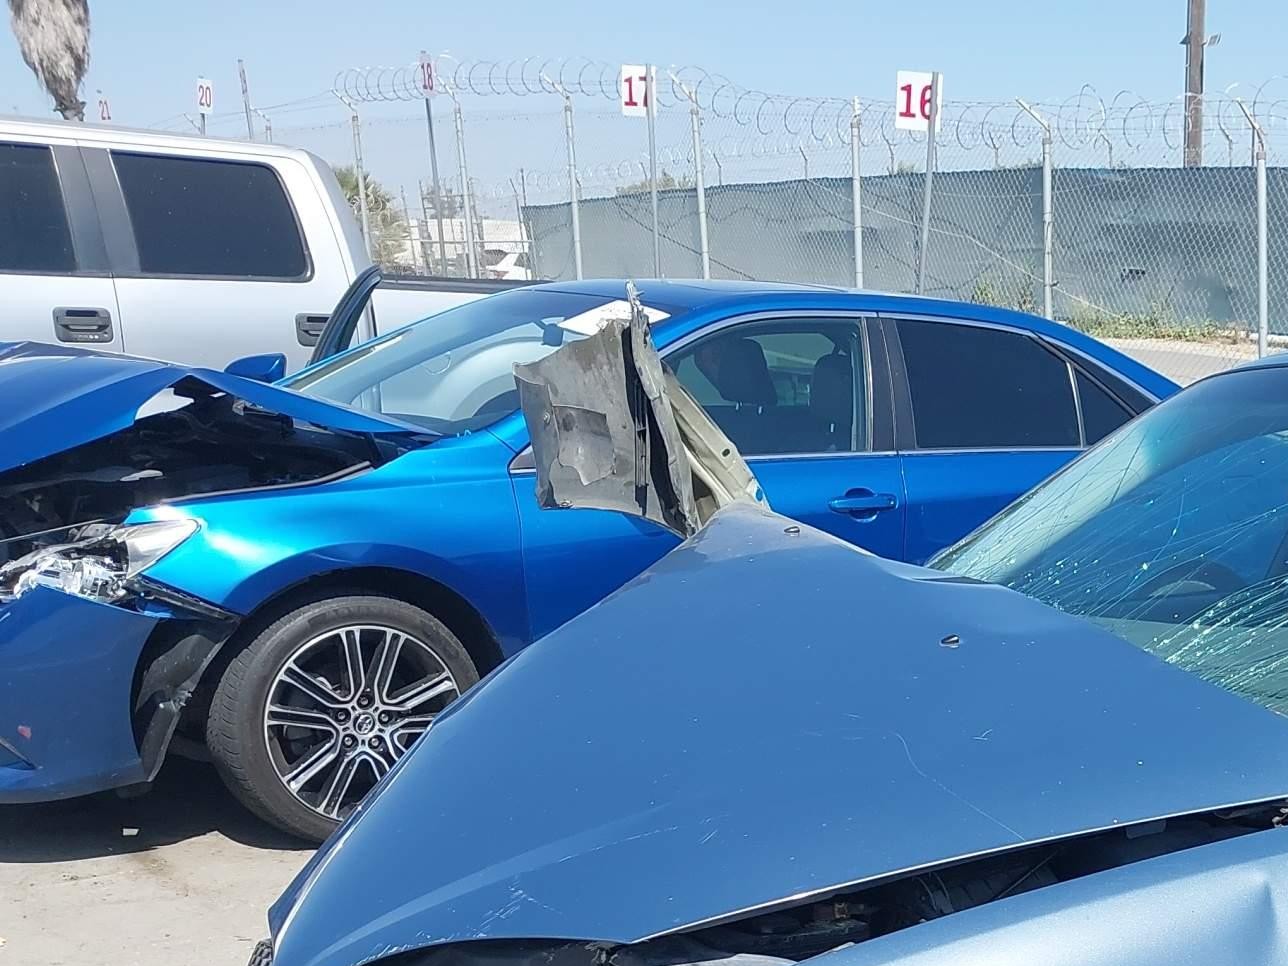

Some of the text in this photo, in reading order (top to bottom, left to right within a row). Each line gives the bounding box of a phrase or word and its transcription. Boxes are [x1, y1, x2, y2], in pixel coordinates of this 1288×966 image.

[420, 62, 434, 91] 18
[198, 85, 212, 108] 20
[98, 99, 112, 120] 21
